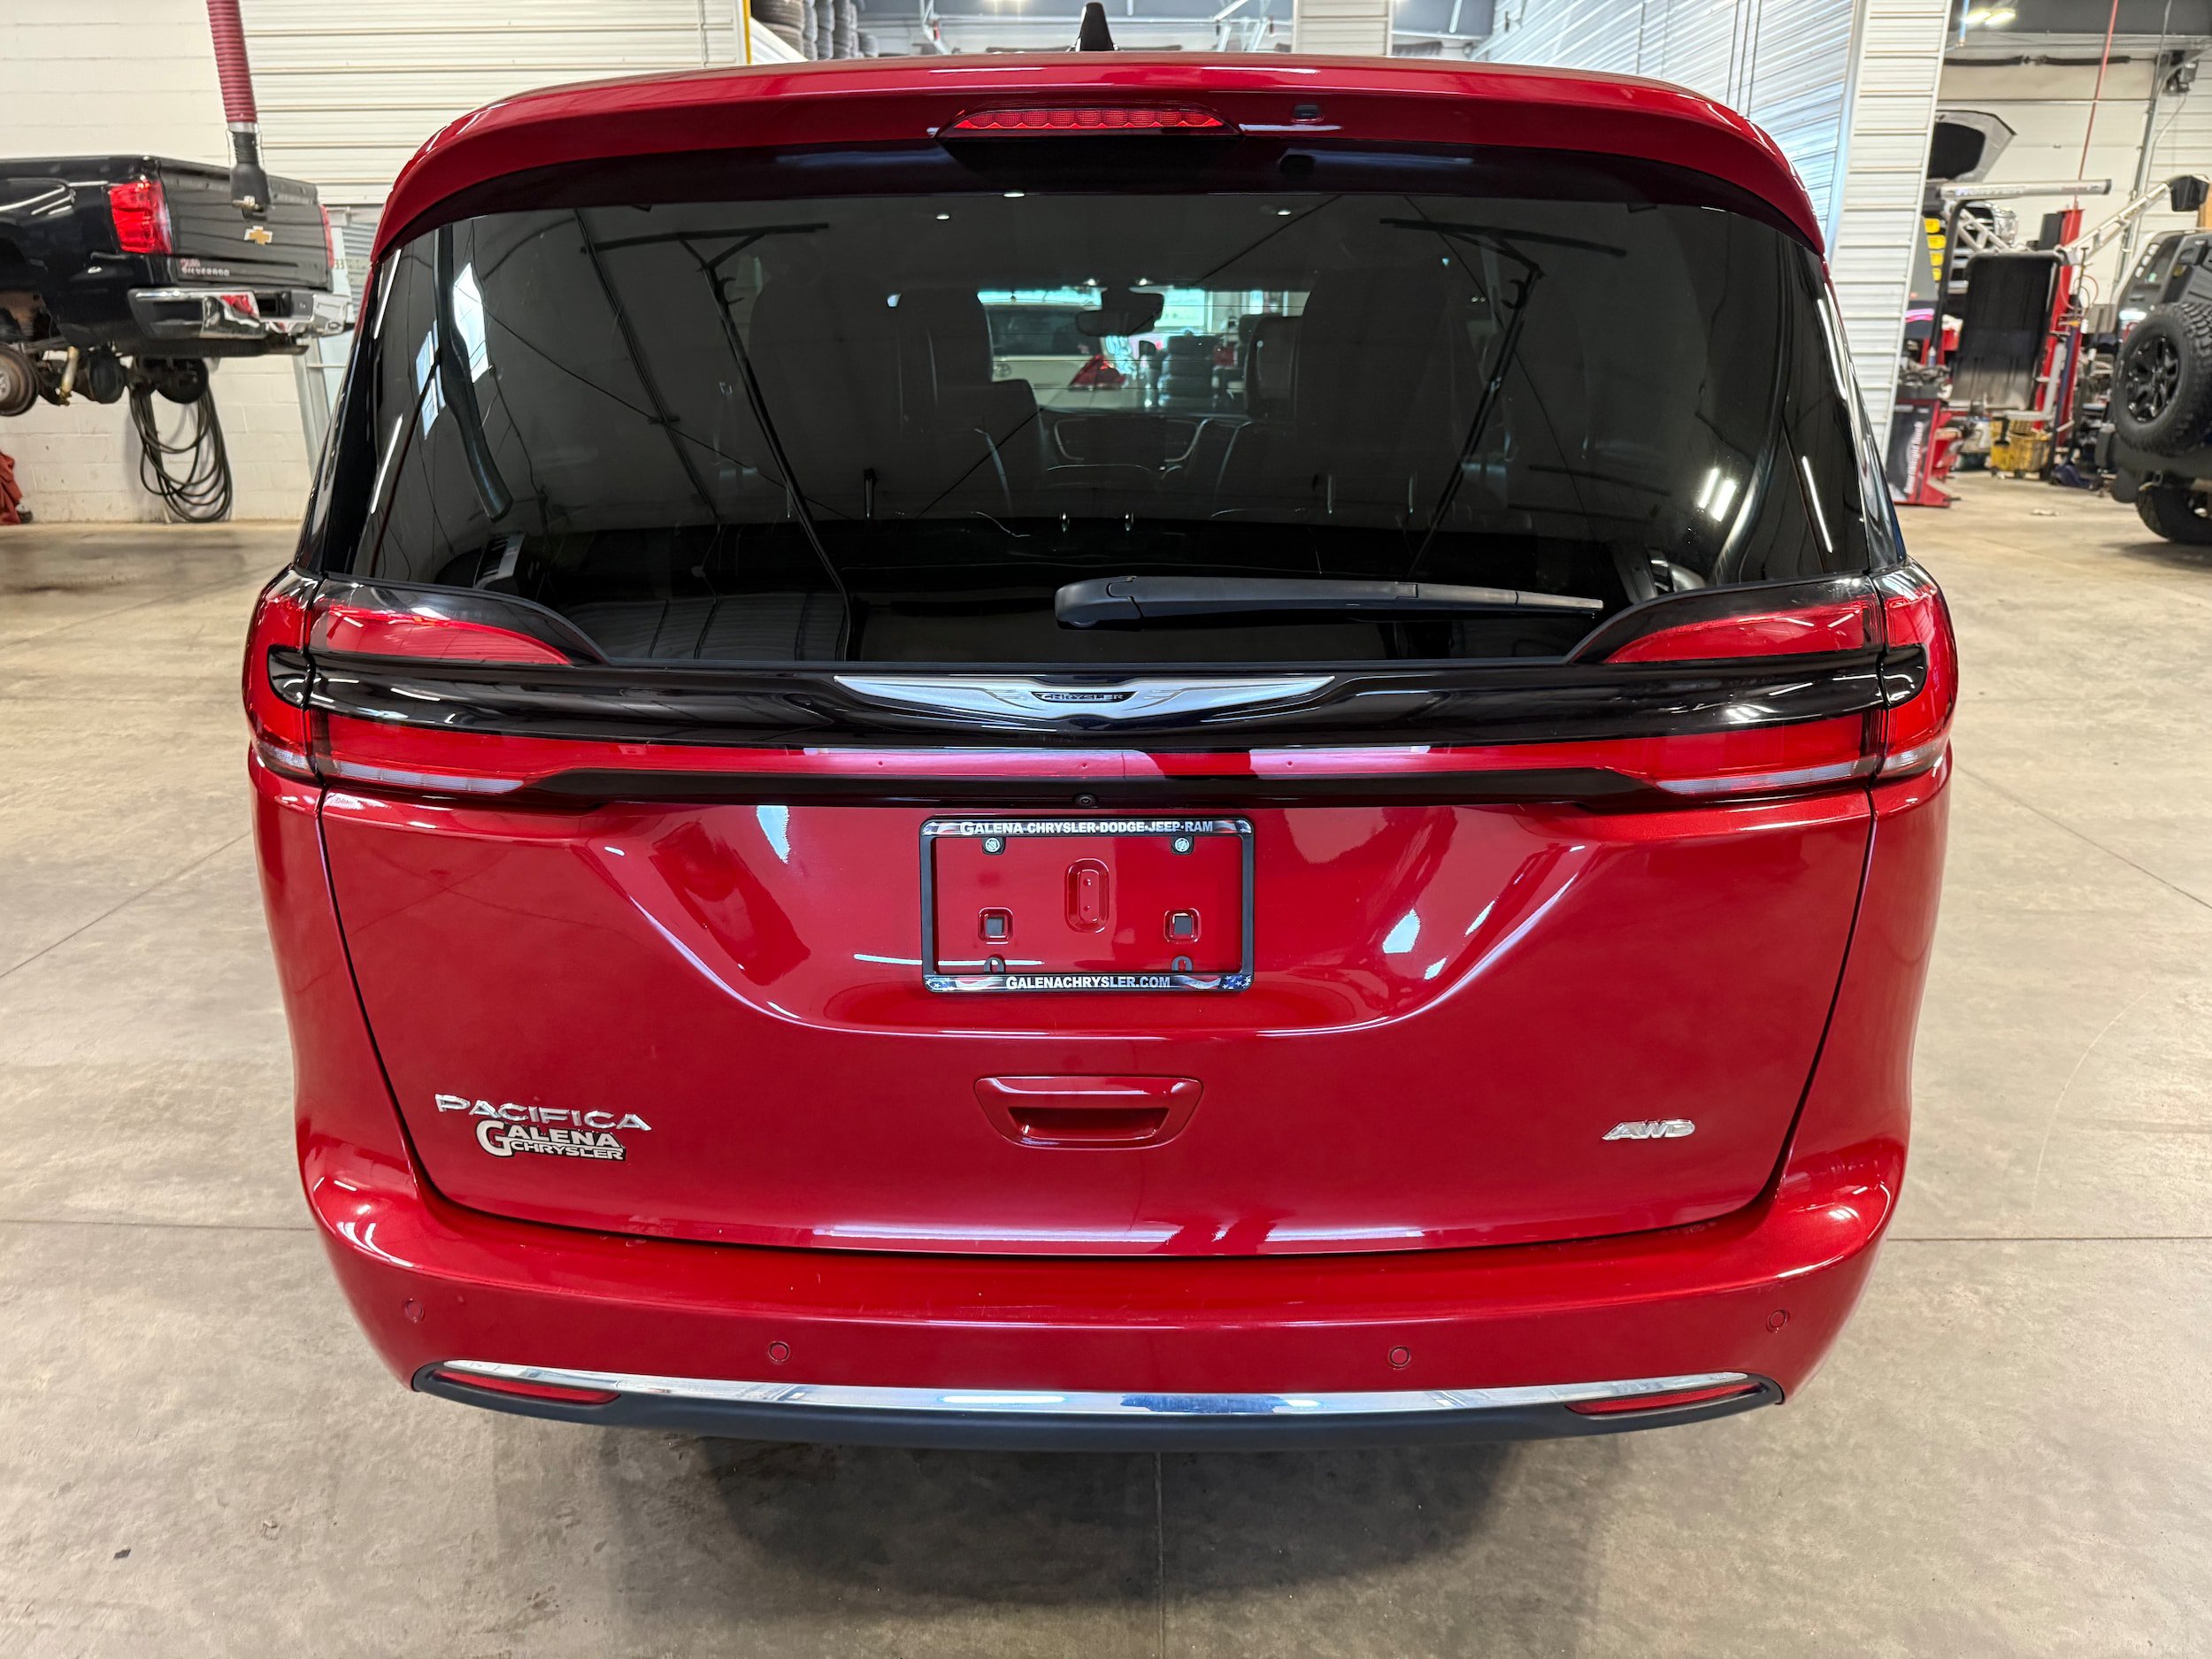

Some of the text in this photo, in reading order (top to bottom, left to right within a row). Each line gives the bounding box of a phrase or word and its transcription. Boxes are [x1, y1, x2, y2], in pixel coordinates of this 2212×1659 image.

[960, 821, 1213, 835] GALENA CHRYSLER DODGE JEEP RAM
[1005, 976, 1171, 989] GALENACHRYSLER.COM
[434, 1094, 653, 1132] PACIFICA
[475, 1118, 626, 1158] GALENA
[1601, 1119, 1696, 1141] AWD
[511, 1141, 625, 1161] CHRYSLER
